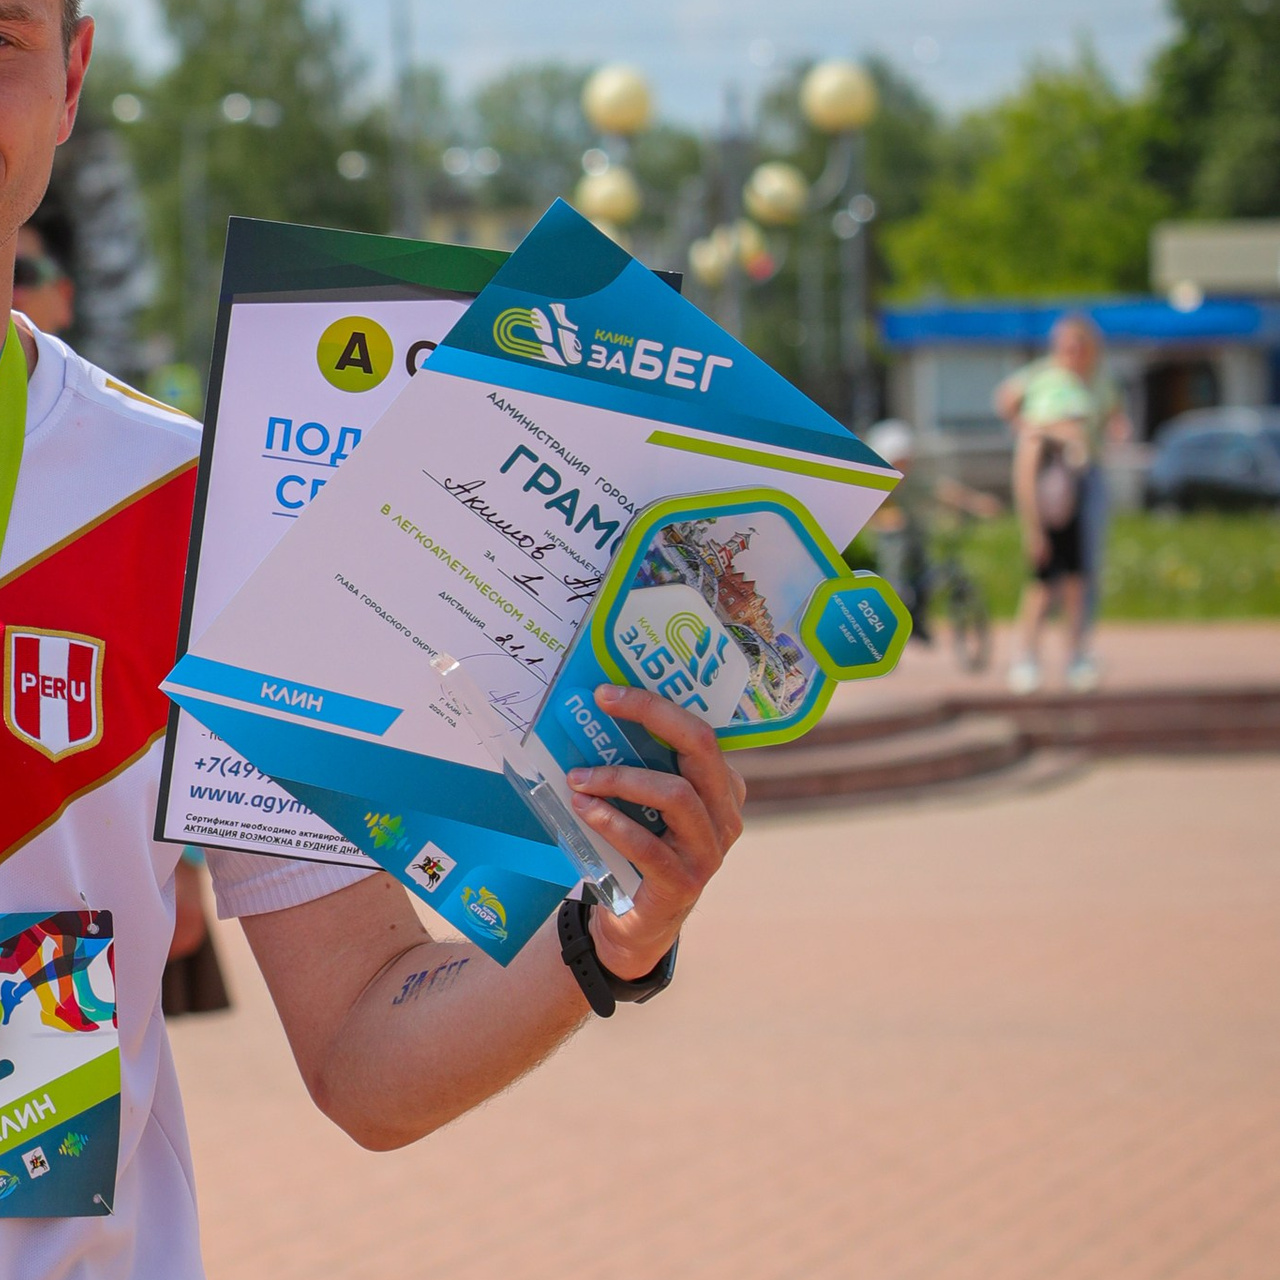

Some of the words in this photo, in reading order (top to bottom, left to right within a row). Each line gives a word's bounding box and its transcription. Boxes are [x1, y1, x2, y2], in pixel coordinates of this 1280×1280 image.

[595, 328, 635, 348] КЛИН
[486, 392, 591, 476] АДМИНИСТРАЦИЯ
[499, 444, 622, 558] ГРАМ
[380, 503, 391, 516] В
[392, 513, 524, 622] ЛЕГКОАТЛЕТИЧЕСКОМ
[483, 549, 496, 563] ЗА
[334, 573, 359, 597] ГЛАВА
[360, 593, 412, 638] ГОРОДСКОГО
[437, 591, 487, 630] ДИСТАНЦИЯ
[856, 599, 885, 633] 2024
[637, 616, 660, 646] КЛИН
[831, 594, 883, 661] ЛЕГКОАТЛЕТИЧЕСКИЙ
[839, 623, 857, 644] ЗАБЕГ
[21, 672, 86, 703] PERU
[260, 681, 324, 713] КЛИН
[428, 703, 445, 717] 2024
[444, 715, 457, 728] ГОД
[183, 824, 238, 838] АКТИВАЦИЯ
[240, 831, 293, 846] ВОЗМОЖНА
[295, 839, 302, 847] В
[303, 840, 339, 852] БУДНИЕ
[339, 845, 361, 856] ДНИ
[185, 813, 240, 827] Сертификат
[240, 821, 297, 836] необходимо
[470, 903, 497, 926] СПОРТ
